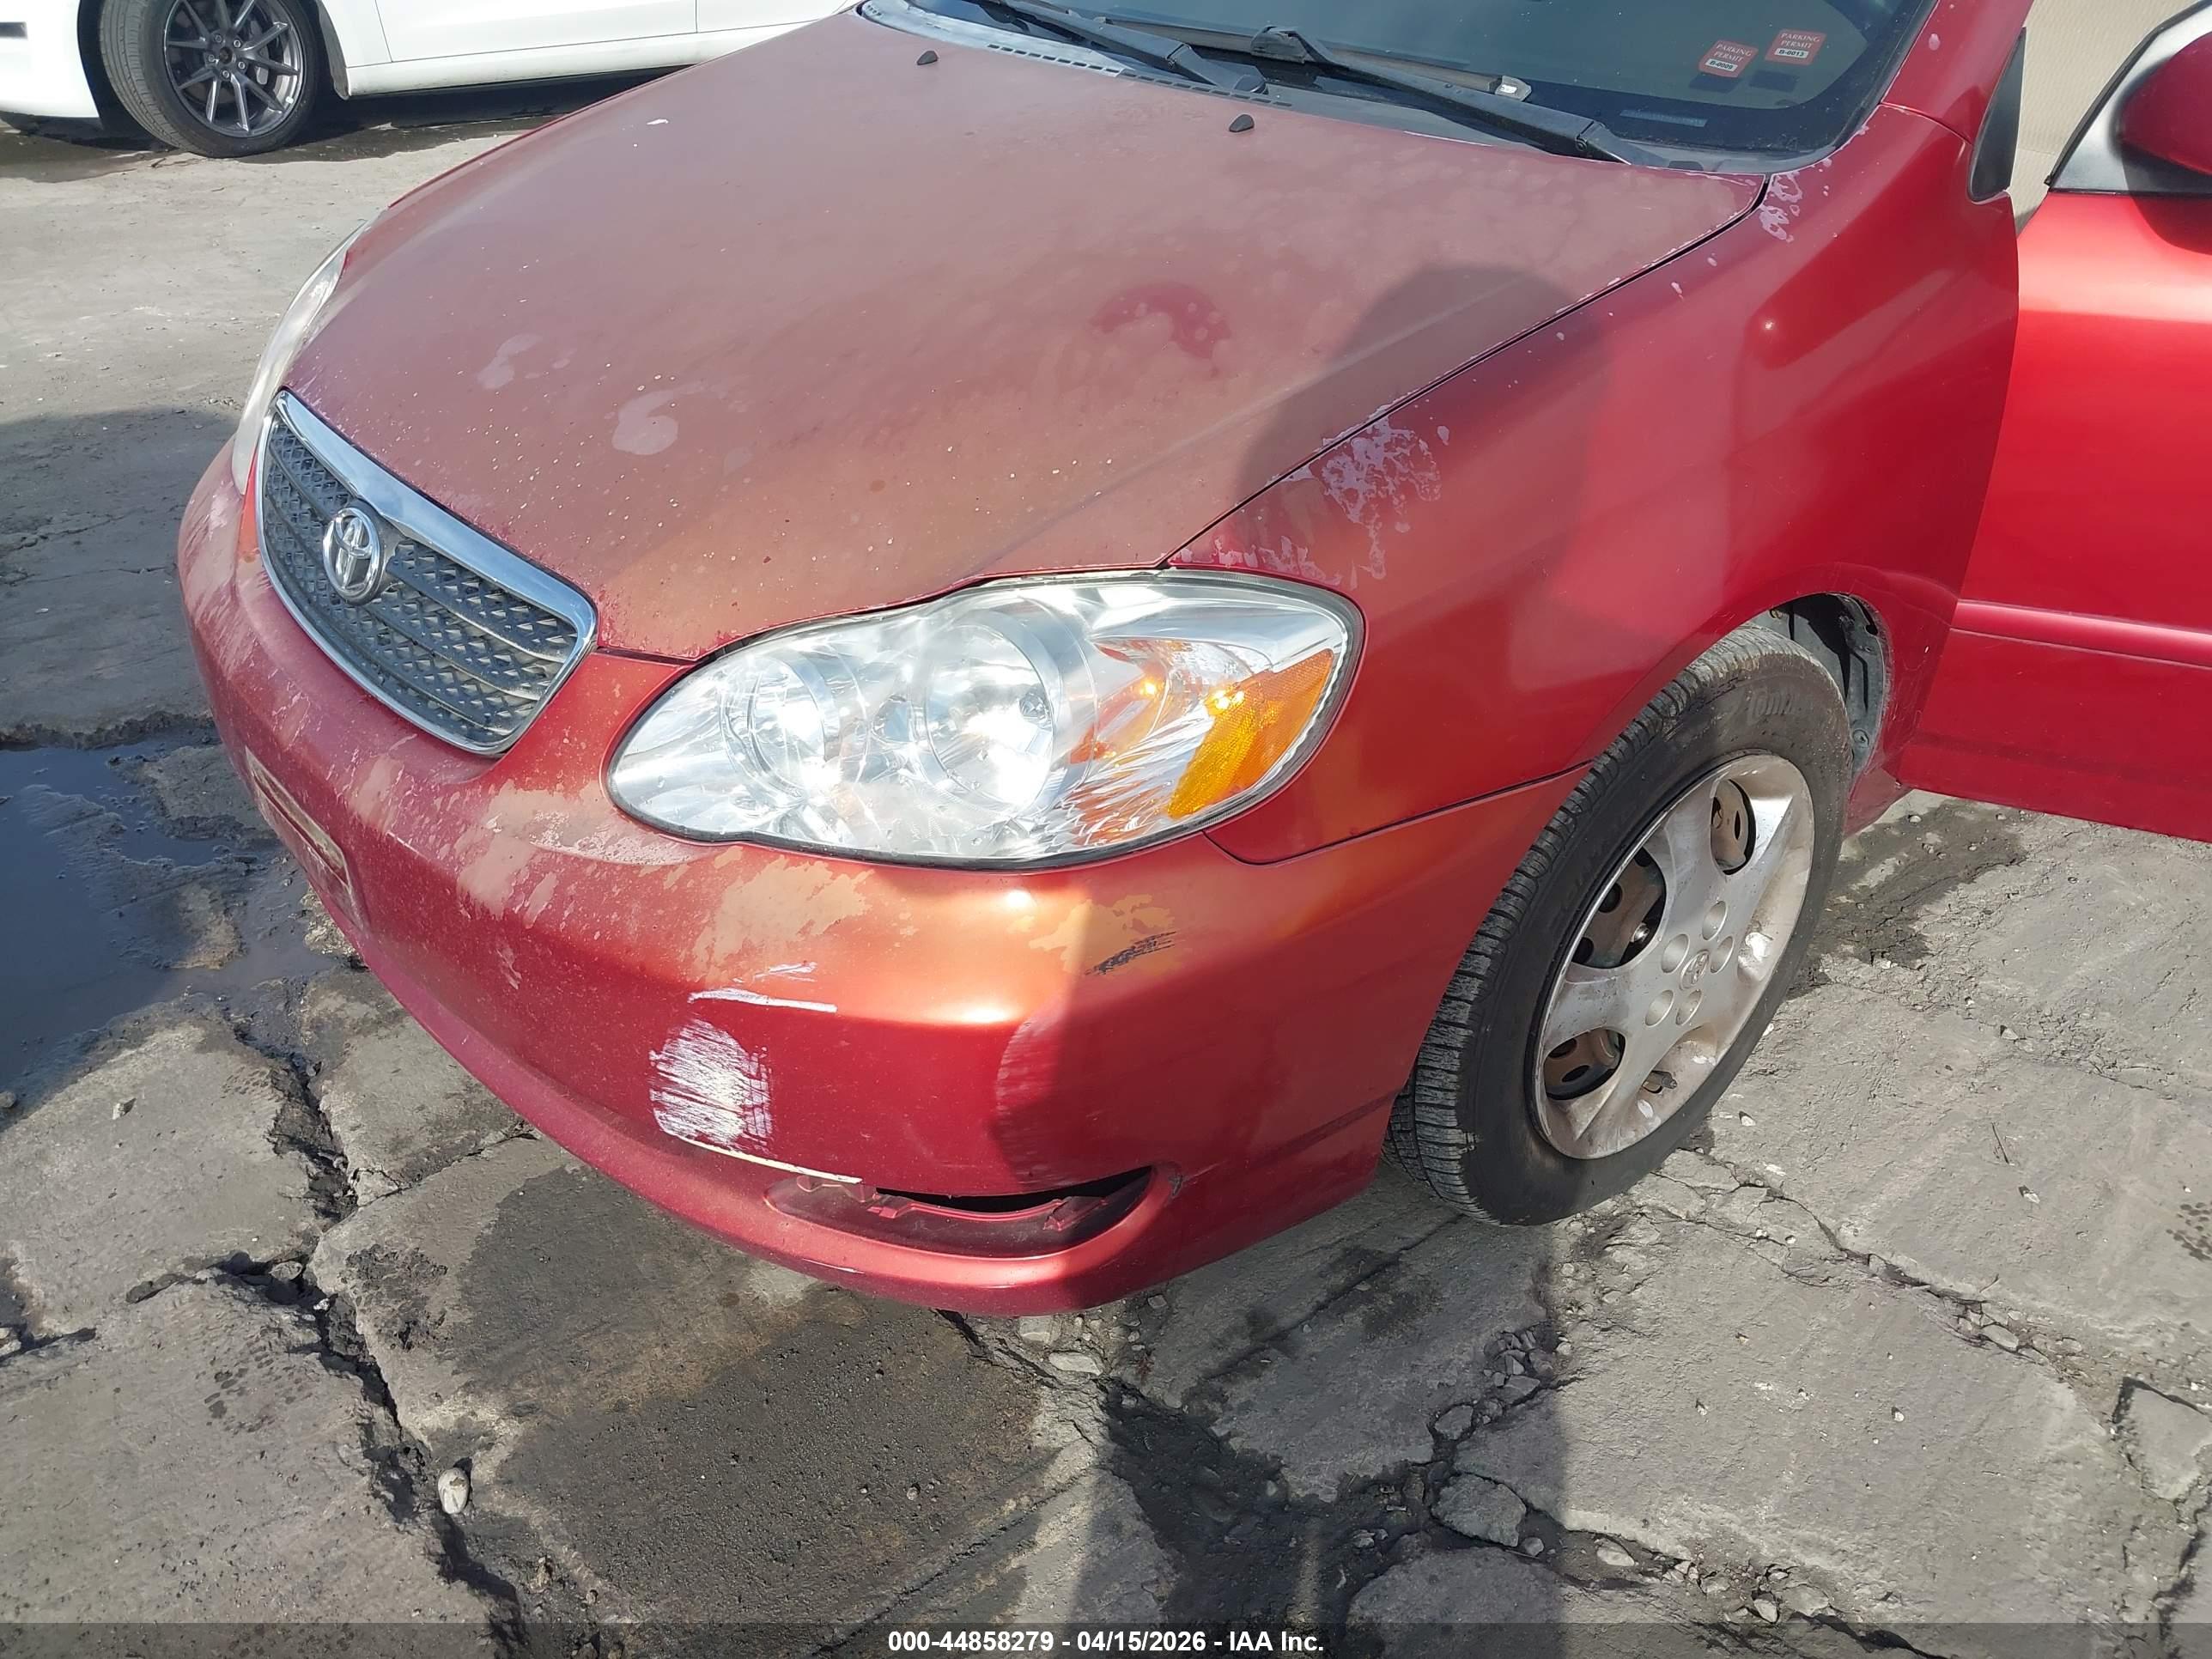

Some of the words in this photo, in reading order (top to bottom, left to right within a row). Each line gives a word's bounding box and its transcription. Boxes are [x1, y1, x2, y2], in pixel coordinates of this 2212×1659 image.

[1781, 33, 1820, 42] PARKING
[1780, 40, 1813, 49] PERMIT
[1716, 44, 1753, 57] PARKING
[1713, 52, 1745, 63] PERMIT
